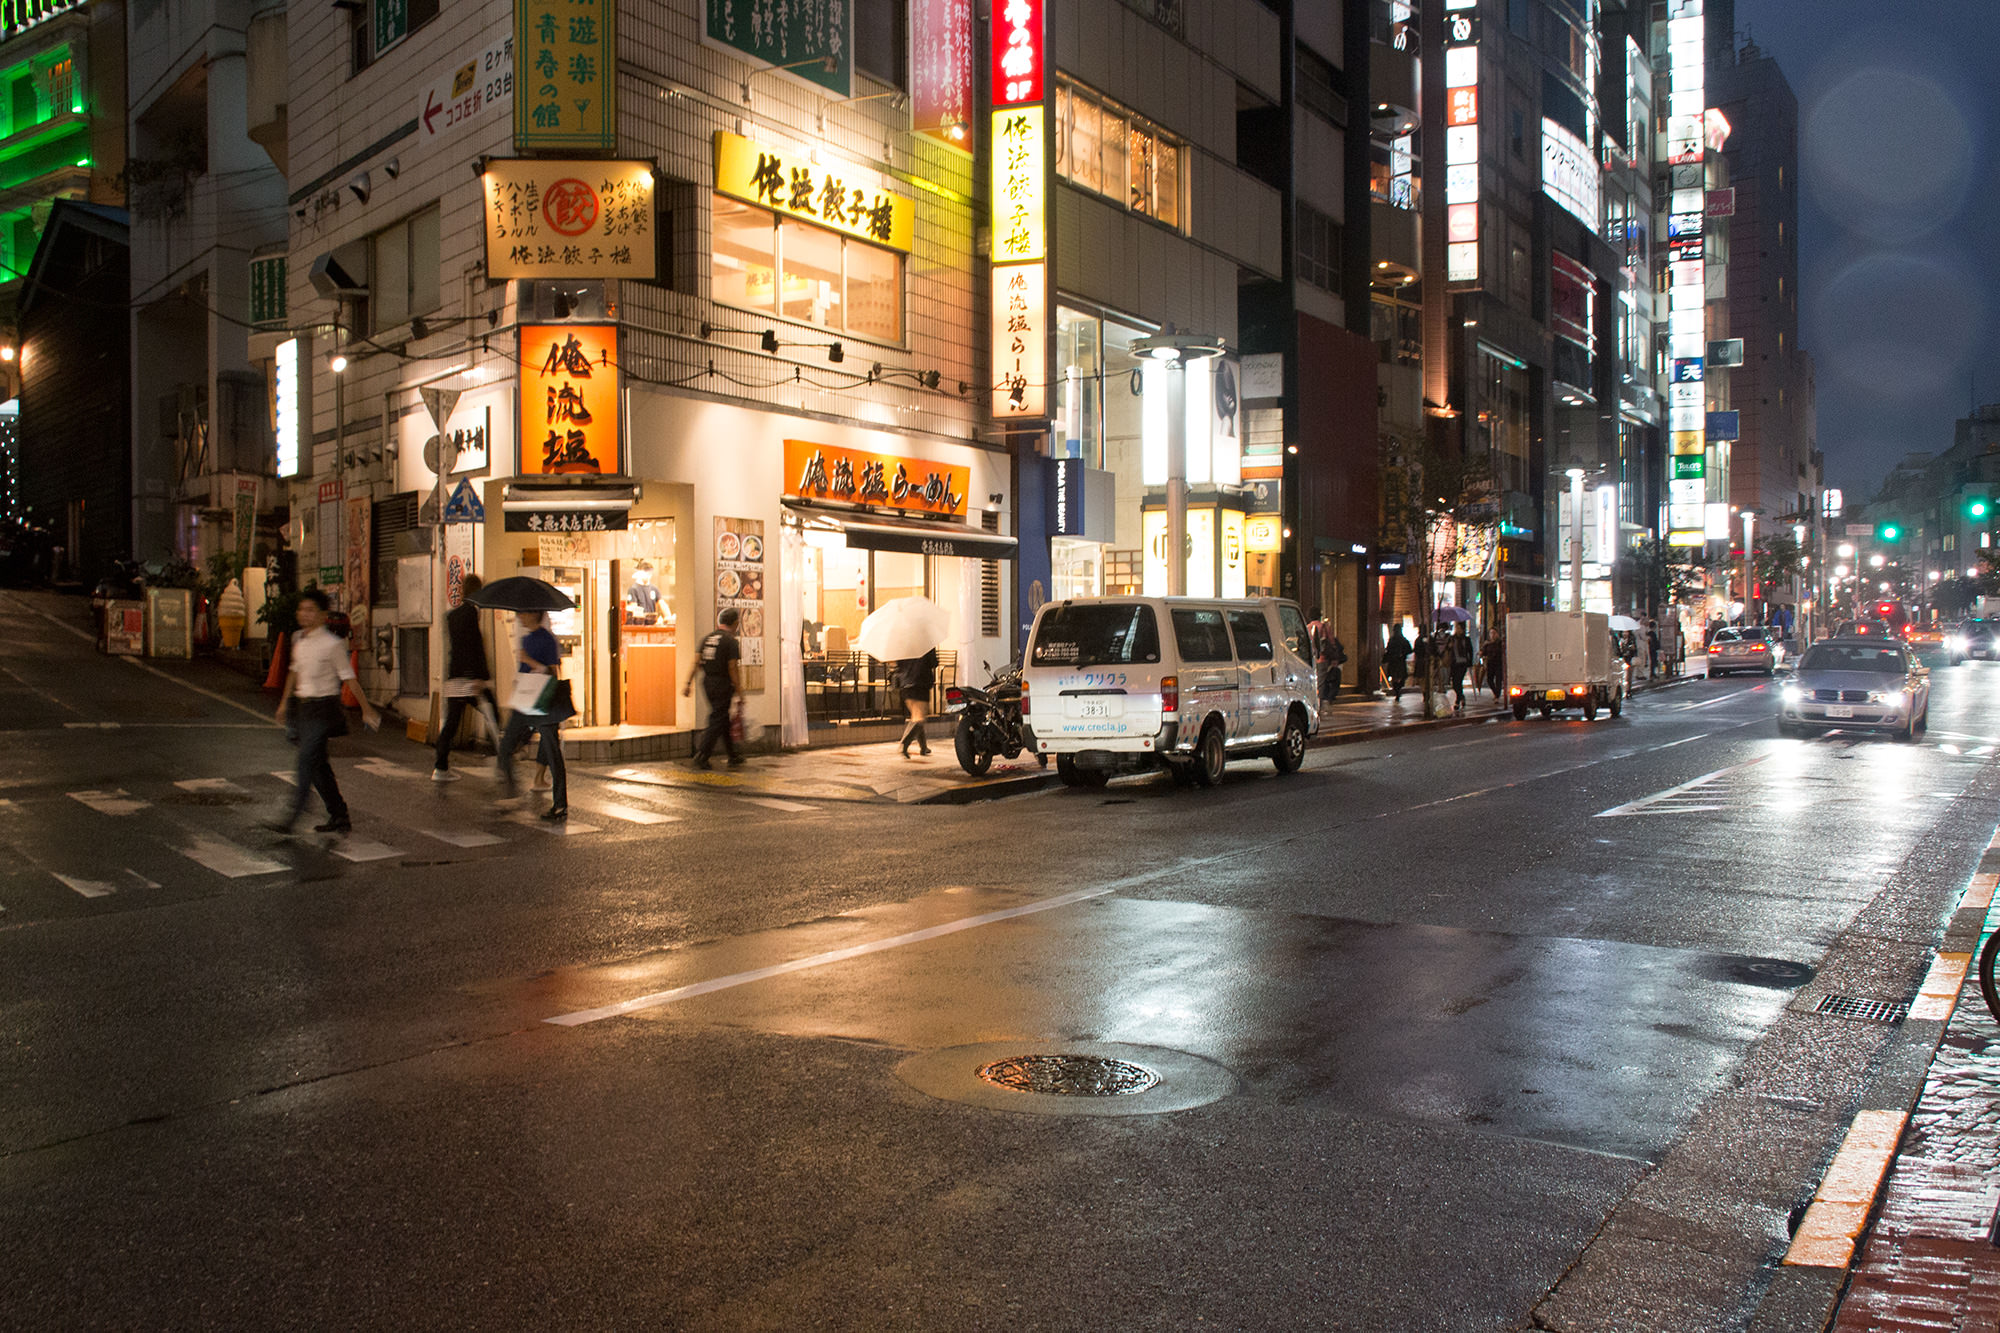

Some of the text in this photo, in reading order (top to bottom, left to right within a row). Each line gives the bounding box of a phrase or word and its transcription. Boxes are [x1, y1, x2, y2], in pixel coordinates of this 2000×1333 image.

[568, 0, 598, 85] 遊楽
[486, 72, 512, 104] 23台
[531, 13, 561, 128] 青春の館
[1005, 80, 1032, 101] 3F
[446, 90, 482, 128] ココ左折
[1675, 154, 1696, 163] LAVA
[493, 183, 507, 239] テキーラ
[506, 181, 524, 238] ハイボール
[525, 180, 538, 237] 生ビール
[549, 185, 593, 226] 餃
[541, 332, 599, 470] 俺流塩
[799, 449, 962, 514] 俺流塩らーめん
[1057, 460, 1066, 533] POLA THE BEAUTY
[527, 513, 607, 532] 東急本店前店
[449, 558, 463, 606] 餃子
[1085, 673, 1127, 686] クリクラ
[1062, 722, 1127, 733] www.crecla.jp
[1085, 706, 1108, 716] 38-31
